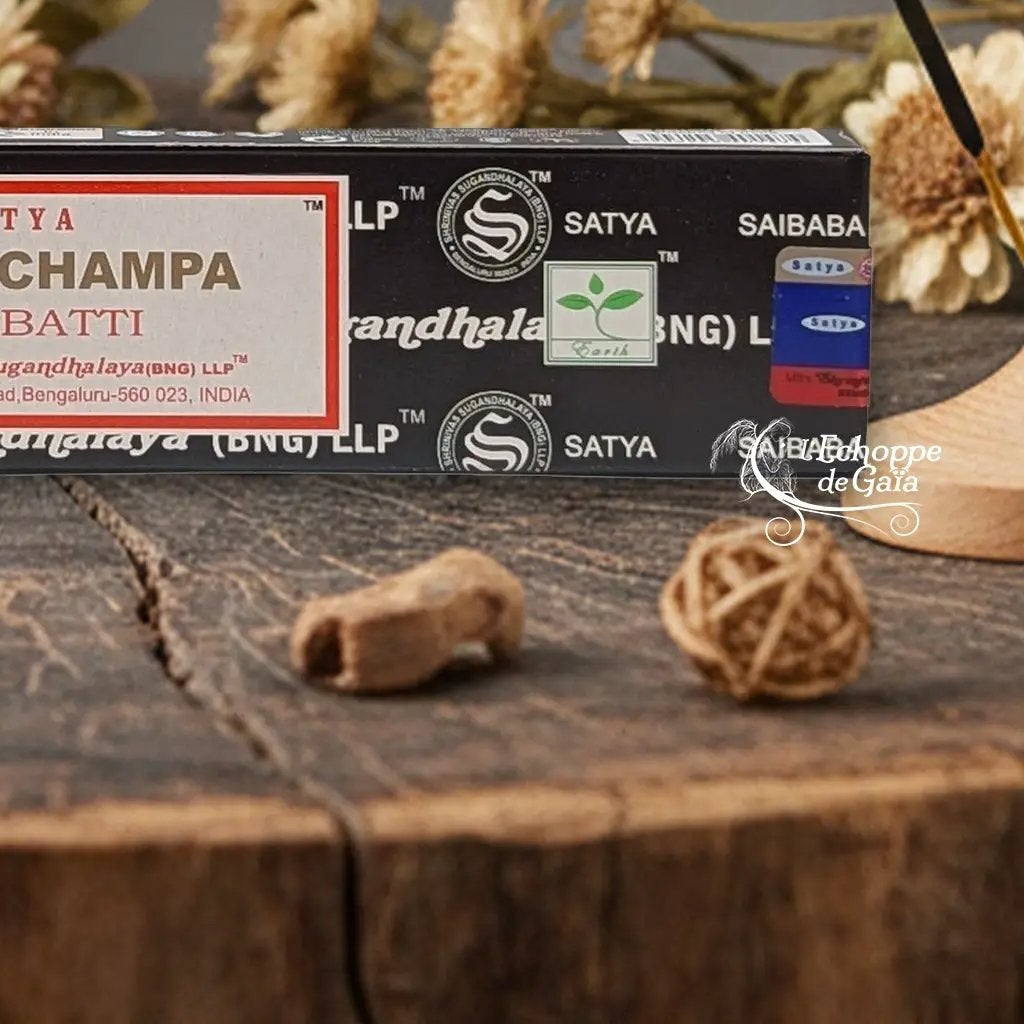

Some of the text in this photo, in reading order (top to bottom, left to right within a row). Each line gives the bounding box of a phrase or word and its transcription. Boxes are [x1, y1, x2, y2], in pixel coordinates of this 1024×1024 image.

[349, 200, 399, 230] LP
[563, 211, 657, 236] SATYA
[737, 213, 866, 238] SAIBABA
[792, 259, 845, 274] Satya
[571, 340, 629, 359] Earth
[156, 387, 193, 404] 023,
[200, 387, 251, 402] INDIA
[563, 434, 657, 459] SATYA
